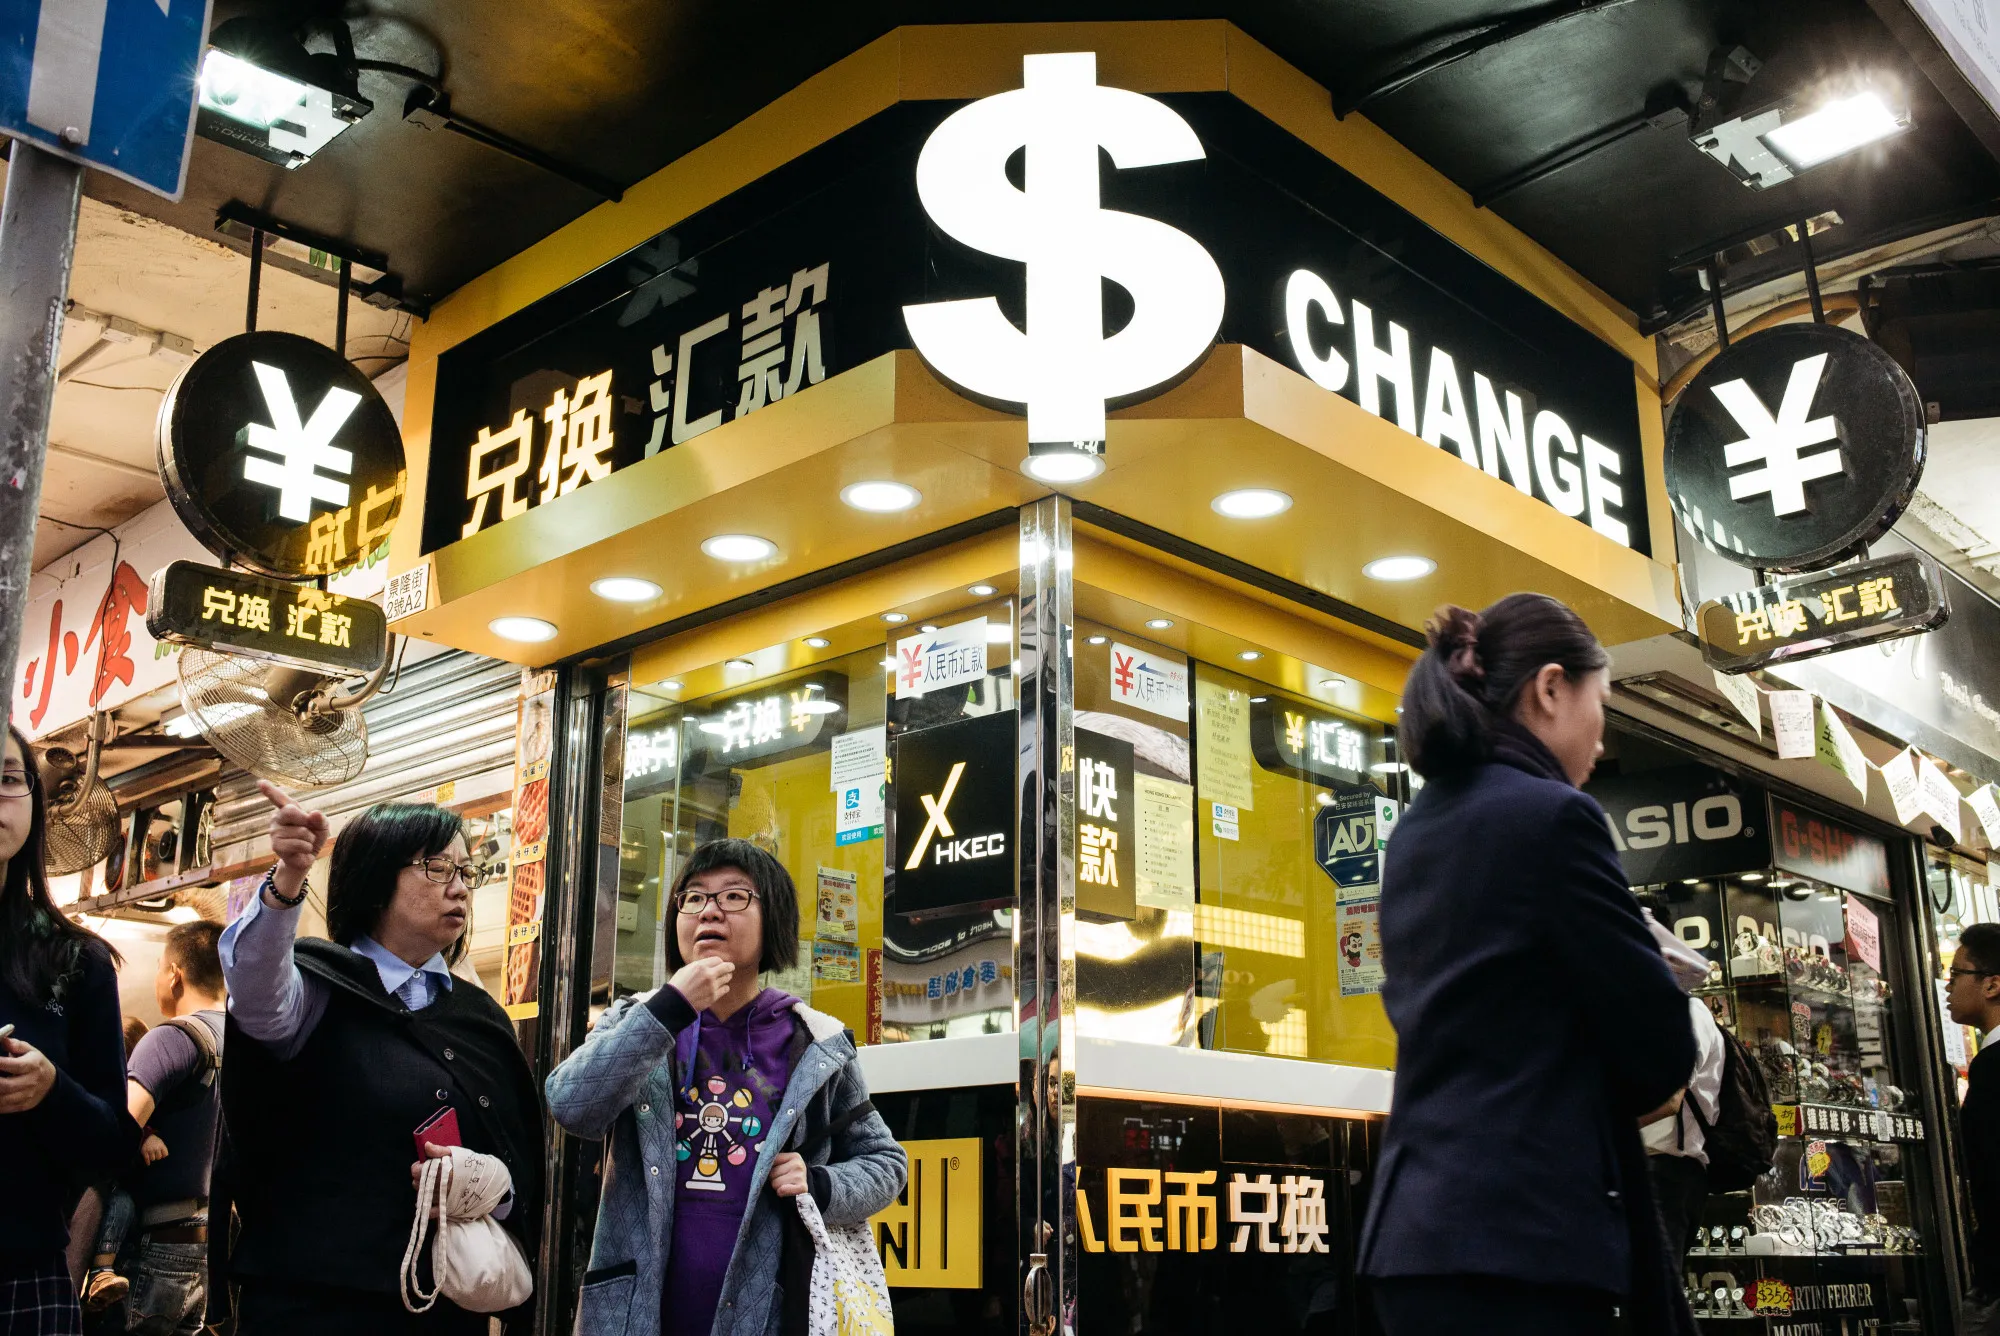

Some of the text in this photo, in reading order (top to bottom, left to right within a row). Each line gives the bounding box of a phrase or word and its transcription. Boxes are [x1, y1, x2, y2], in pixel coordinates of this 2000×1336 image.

[902, 51, 1226, 442] $
[461, 368, 613, 540] 兑换
[644, 261, 830, 461] 汇款
[1285, 268, 1631, 549] CHANGE
[243, 360, 363, 524] ¥
[1710, 352, 1847, 518] ¥
[386, 596, 423, 621] 2號A2
[388, 569, 424, 598] 景隆街
[1735, 576, 1899, 646] 兑换 汇款
[202, 586, 352, 649] 兑换 汇款
[924, 644, 983, 684] 人民币汇款
[1340, 791, 1370, 801] Secured by
[1604, 794, 1743, 852] SIO
[936, 833, 1004, 865] HKEC
[1329, 815, 1378, 856] ADT
[1226, 1173, 1330, 1253] 兑换
[1757, 1287, 1790, 1305] $350
[1792, 1283, 1874, 1311] RTIN FERRER
